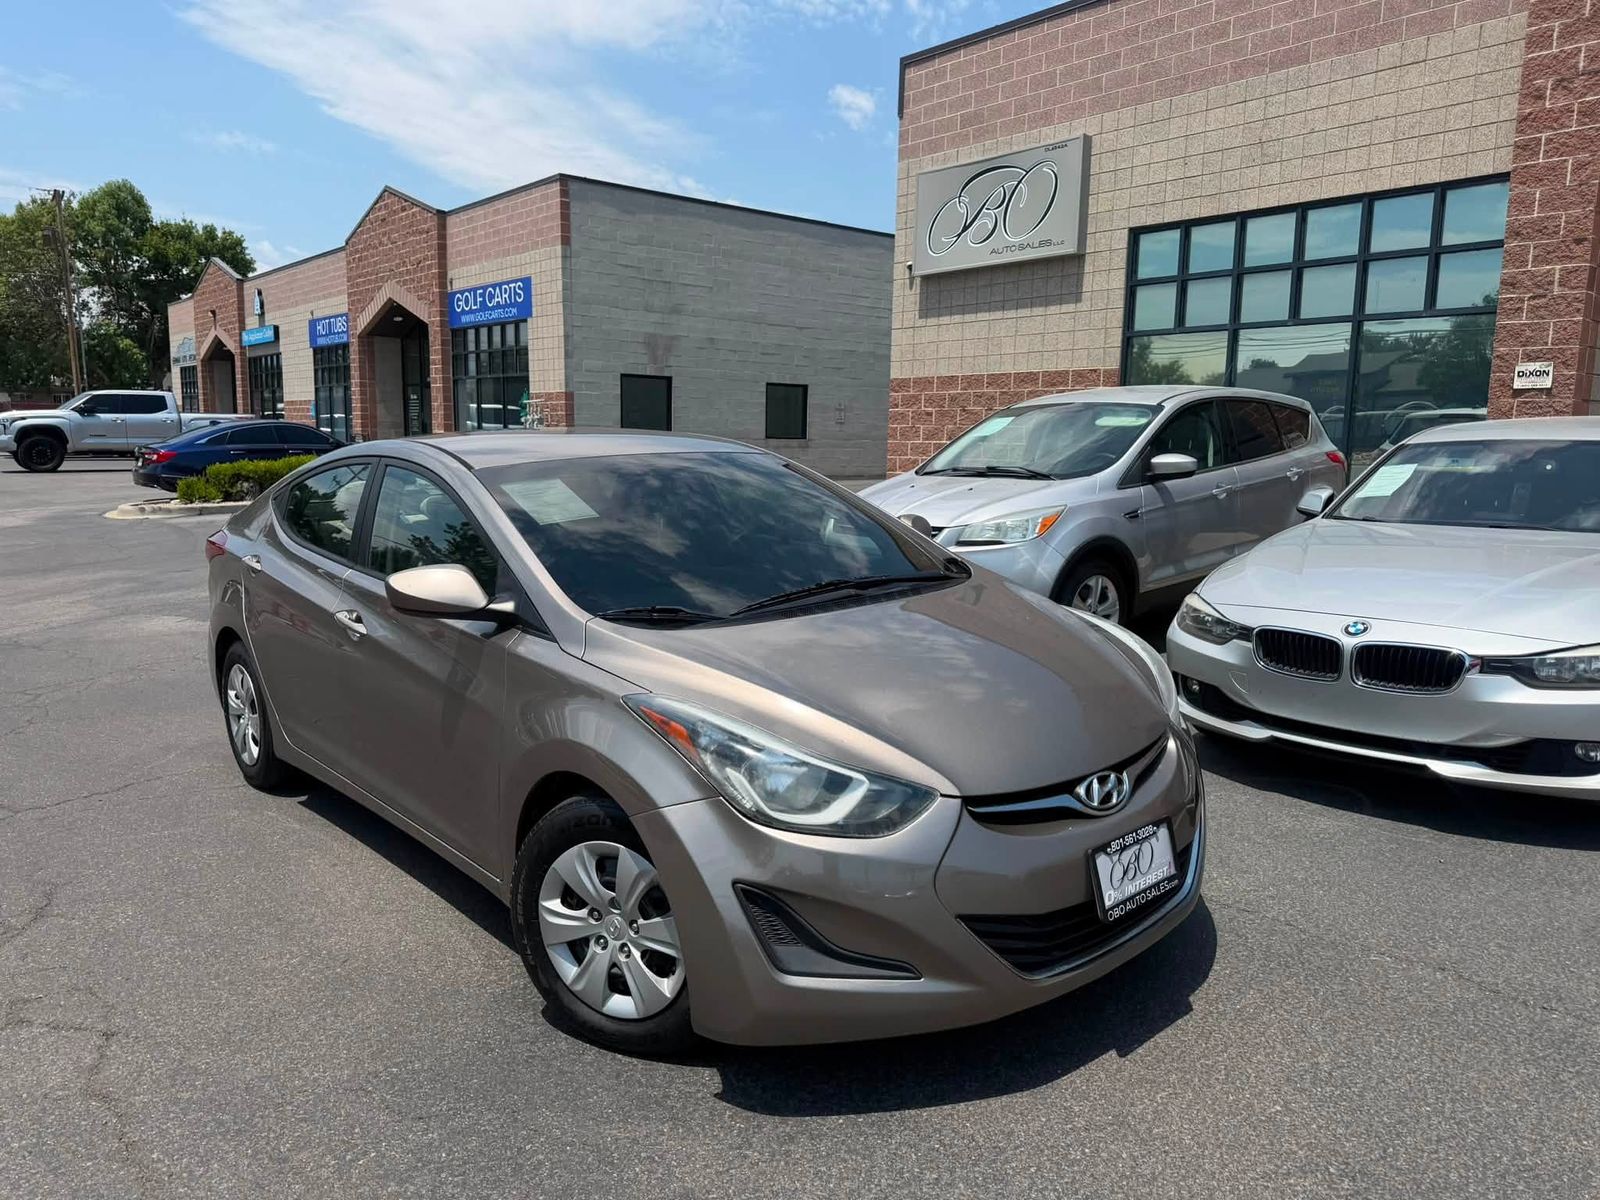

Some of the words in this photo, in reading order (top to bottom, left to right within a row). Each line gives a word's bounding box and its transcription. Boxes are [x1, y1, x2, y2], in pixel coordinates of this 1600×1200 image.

[989, 244, 1017, 256] AUTO
[1017, 238, 1053, 251] SALES
[454, 289, 484, 312] GOLF
[485, 281, 524, 307] CARTS
[316, 319, 330, 336] HOT
[330, 315, 348, 333] TUBS
[460, 307, 518, 323] WWW.GOLFCARTS.COM
[1107, 904, 1126, 921] OBO
[1126, 894, 1147, 912] AUTO
